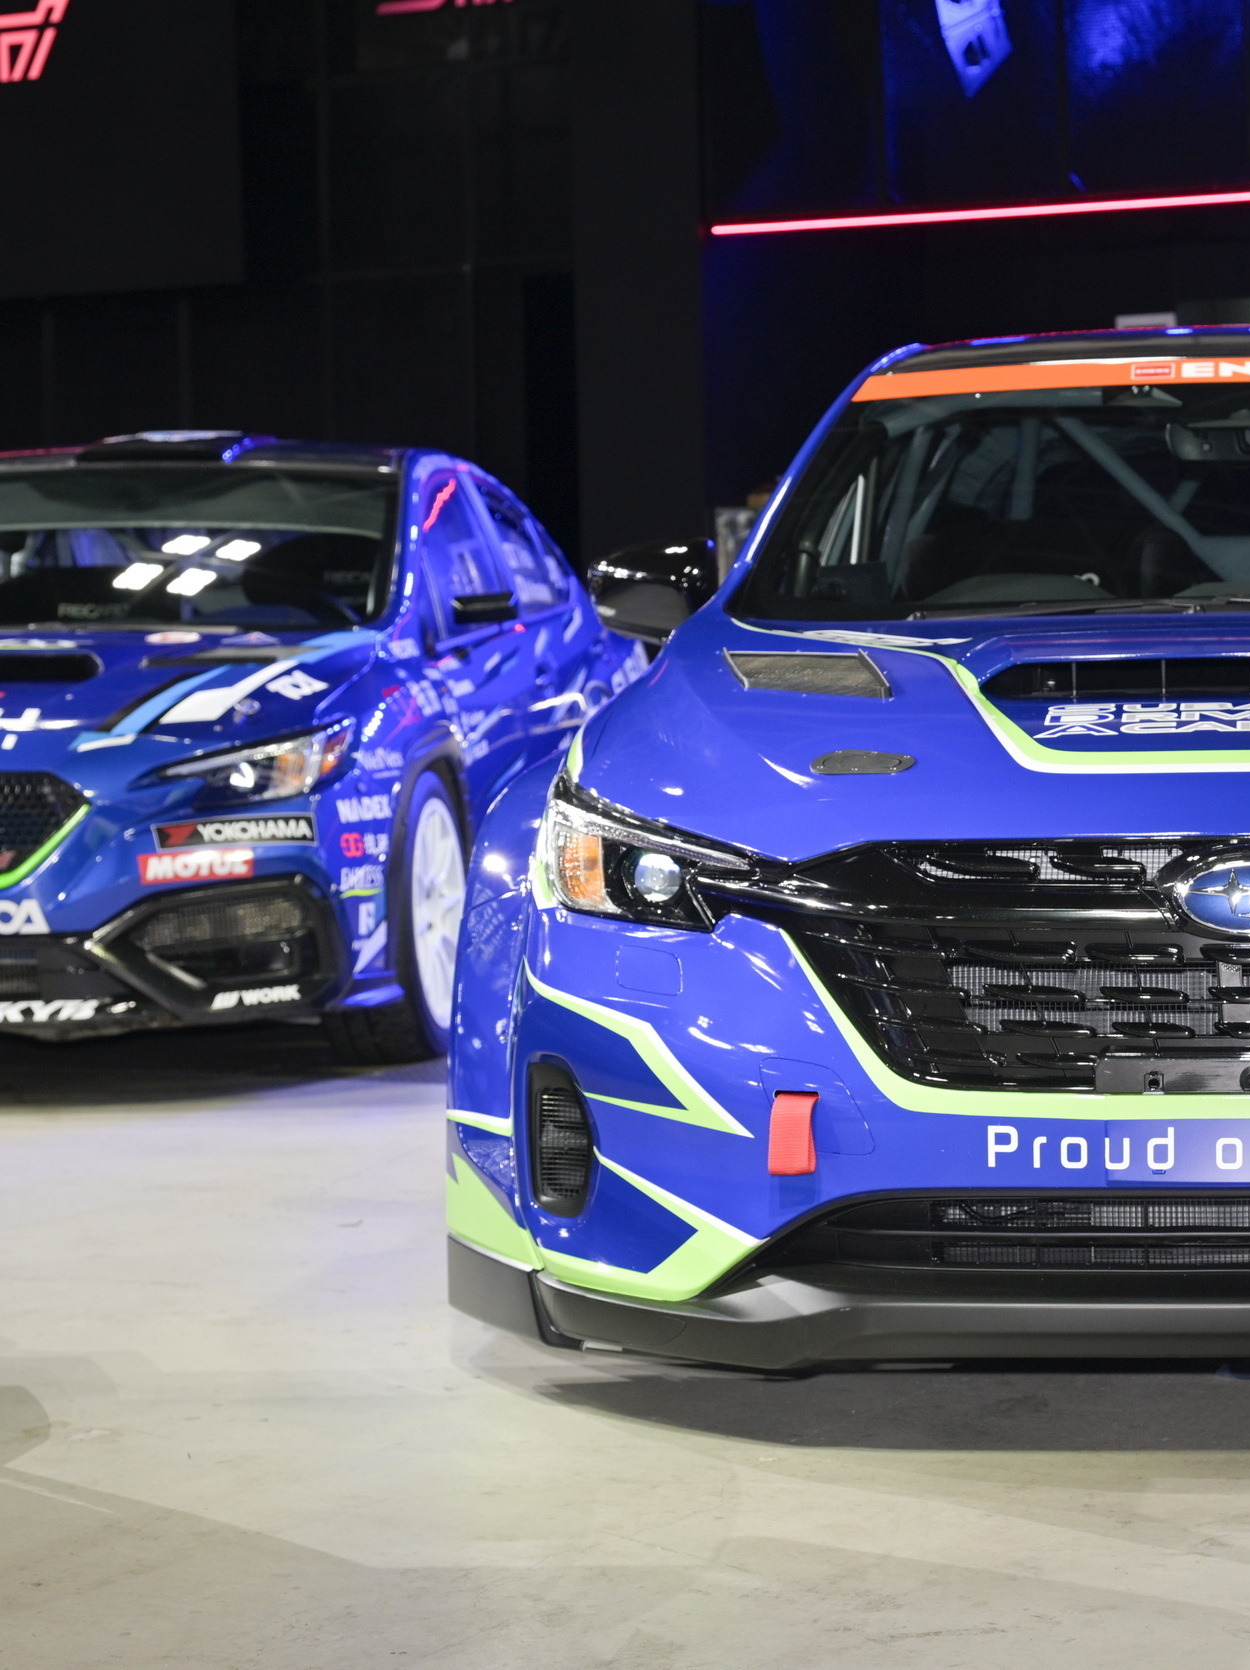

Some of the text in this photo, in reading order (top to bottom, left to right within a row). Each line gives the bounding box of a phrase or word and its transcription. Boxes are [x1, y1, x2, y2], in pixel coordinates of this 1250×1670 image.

[197, 819, 312, 842] YOKOHAMA
[145, 852, 249, 881] MOTUL
[240, 984, 301, 1006] WORK
[987, 1125, 1175, 1169] Proud
